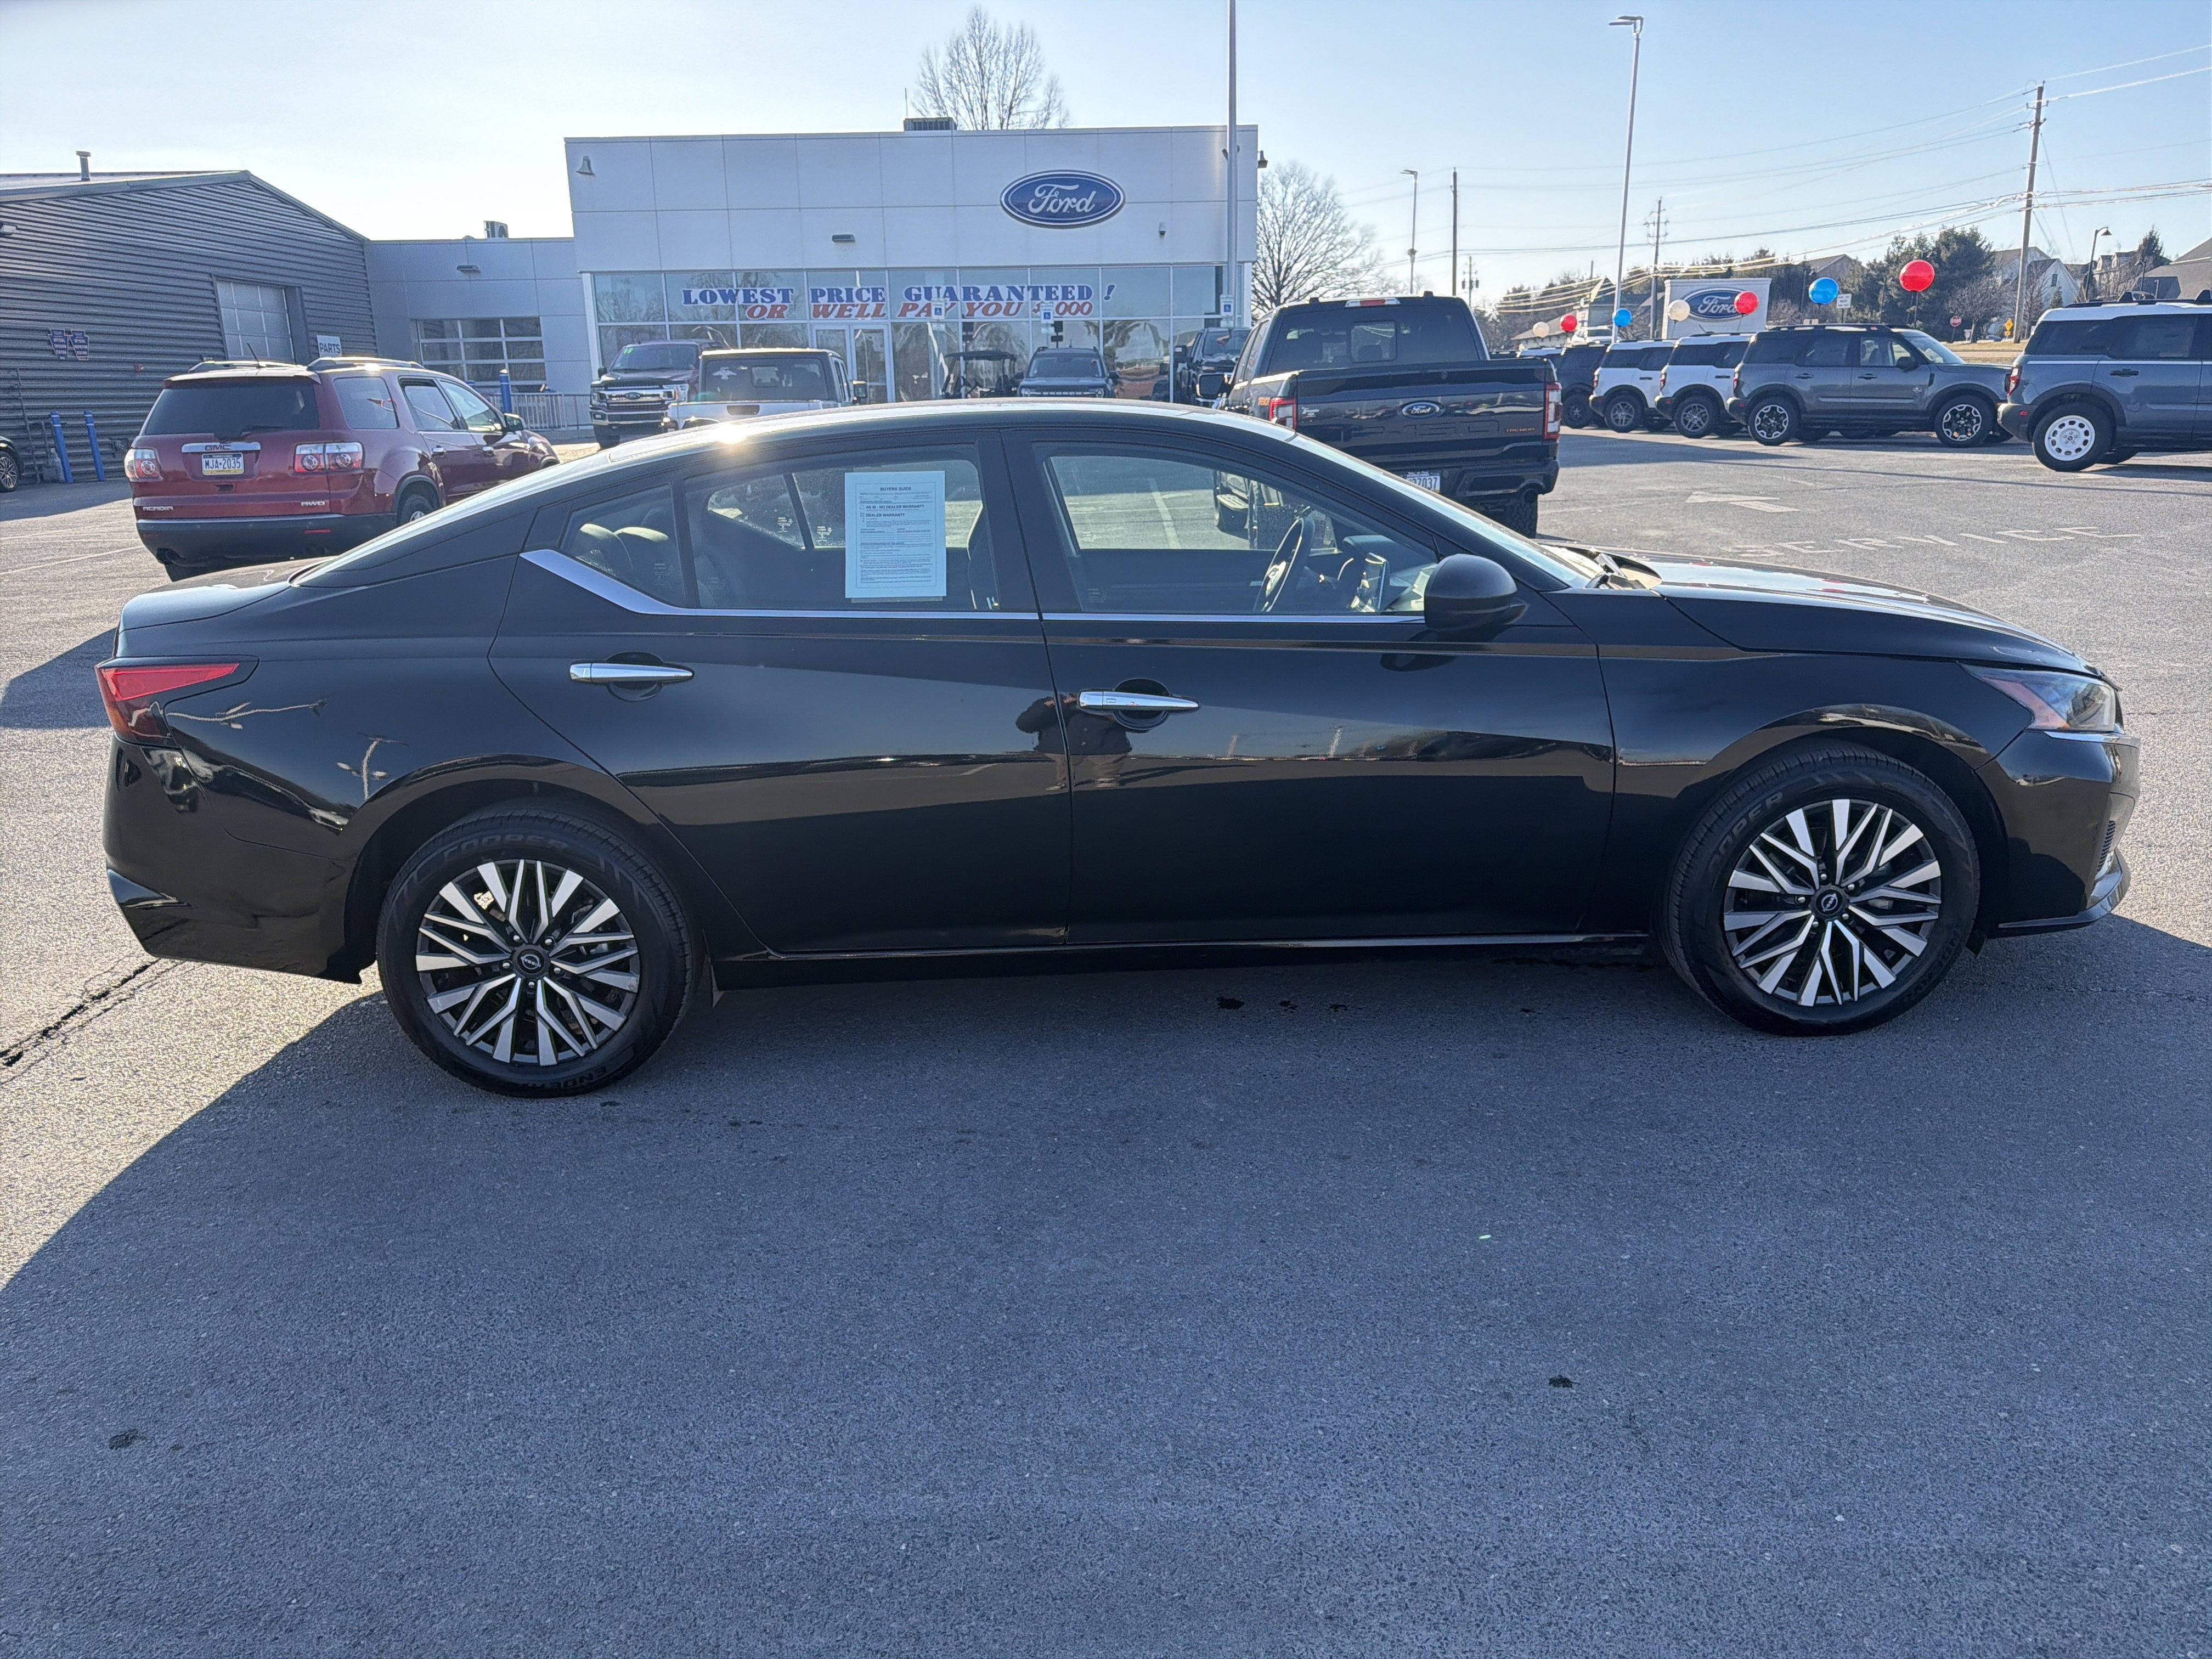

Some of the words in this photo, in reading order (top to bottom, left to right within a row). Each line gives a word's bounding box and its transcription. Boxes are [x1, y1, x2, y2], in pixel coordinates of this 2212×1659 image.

[1028, 183, 1097, 213] Ford
[682, 288, 794, 304] LOWEST
[809, 287, 885, 303] PRICE
[904, 285, 1093, 302] GUARANTEED
[747, 304, 788, 319] OR
[812, 303, 886, 319] WE'LL
[898, 302, 957, 318] PAY
[966, 302, 1024, 317] YOU
[319, 342, 341, 354] PARTS
